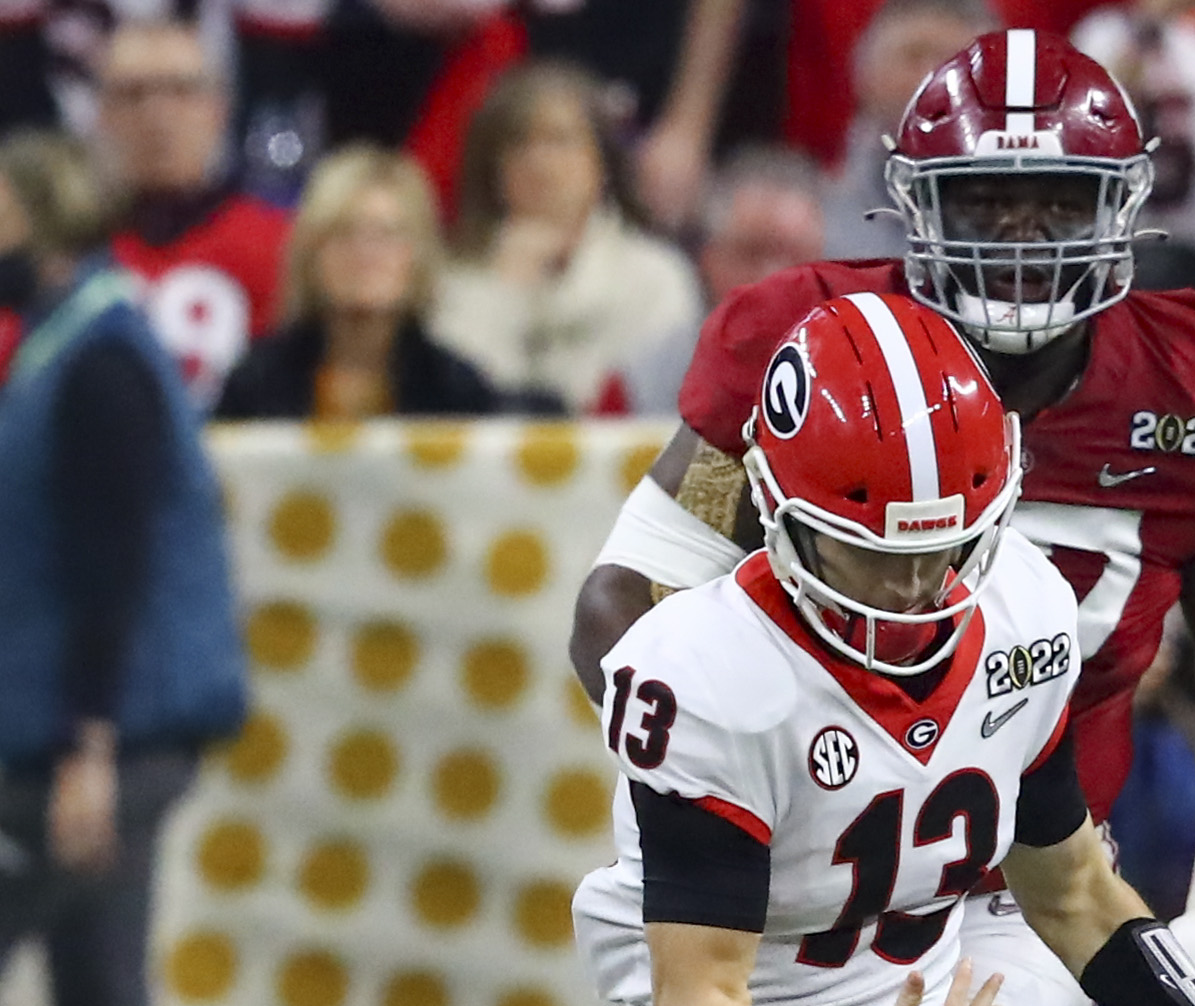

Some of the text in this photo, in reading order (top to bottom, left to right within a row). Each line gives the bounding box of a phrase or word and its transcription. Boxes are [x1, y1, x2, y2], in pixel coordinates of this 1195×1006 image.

[997, 135, 1040, 149] BAMA
[764, 344, 809, 436] G
[898, 515, 957, 532] DAWGS
[986, 632, 1071, 699] 2022
[608, 665, 677, 770] 13
[906, 719, 939, 749] G
[813, 730, 855, 786] SEC
[795, 767, 1000, 968] 13
